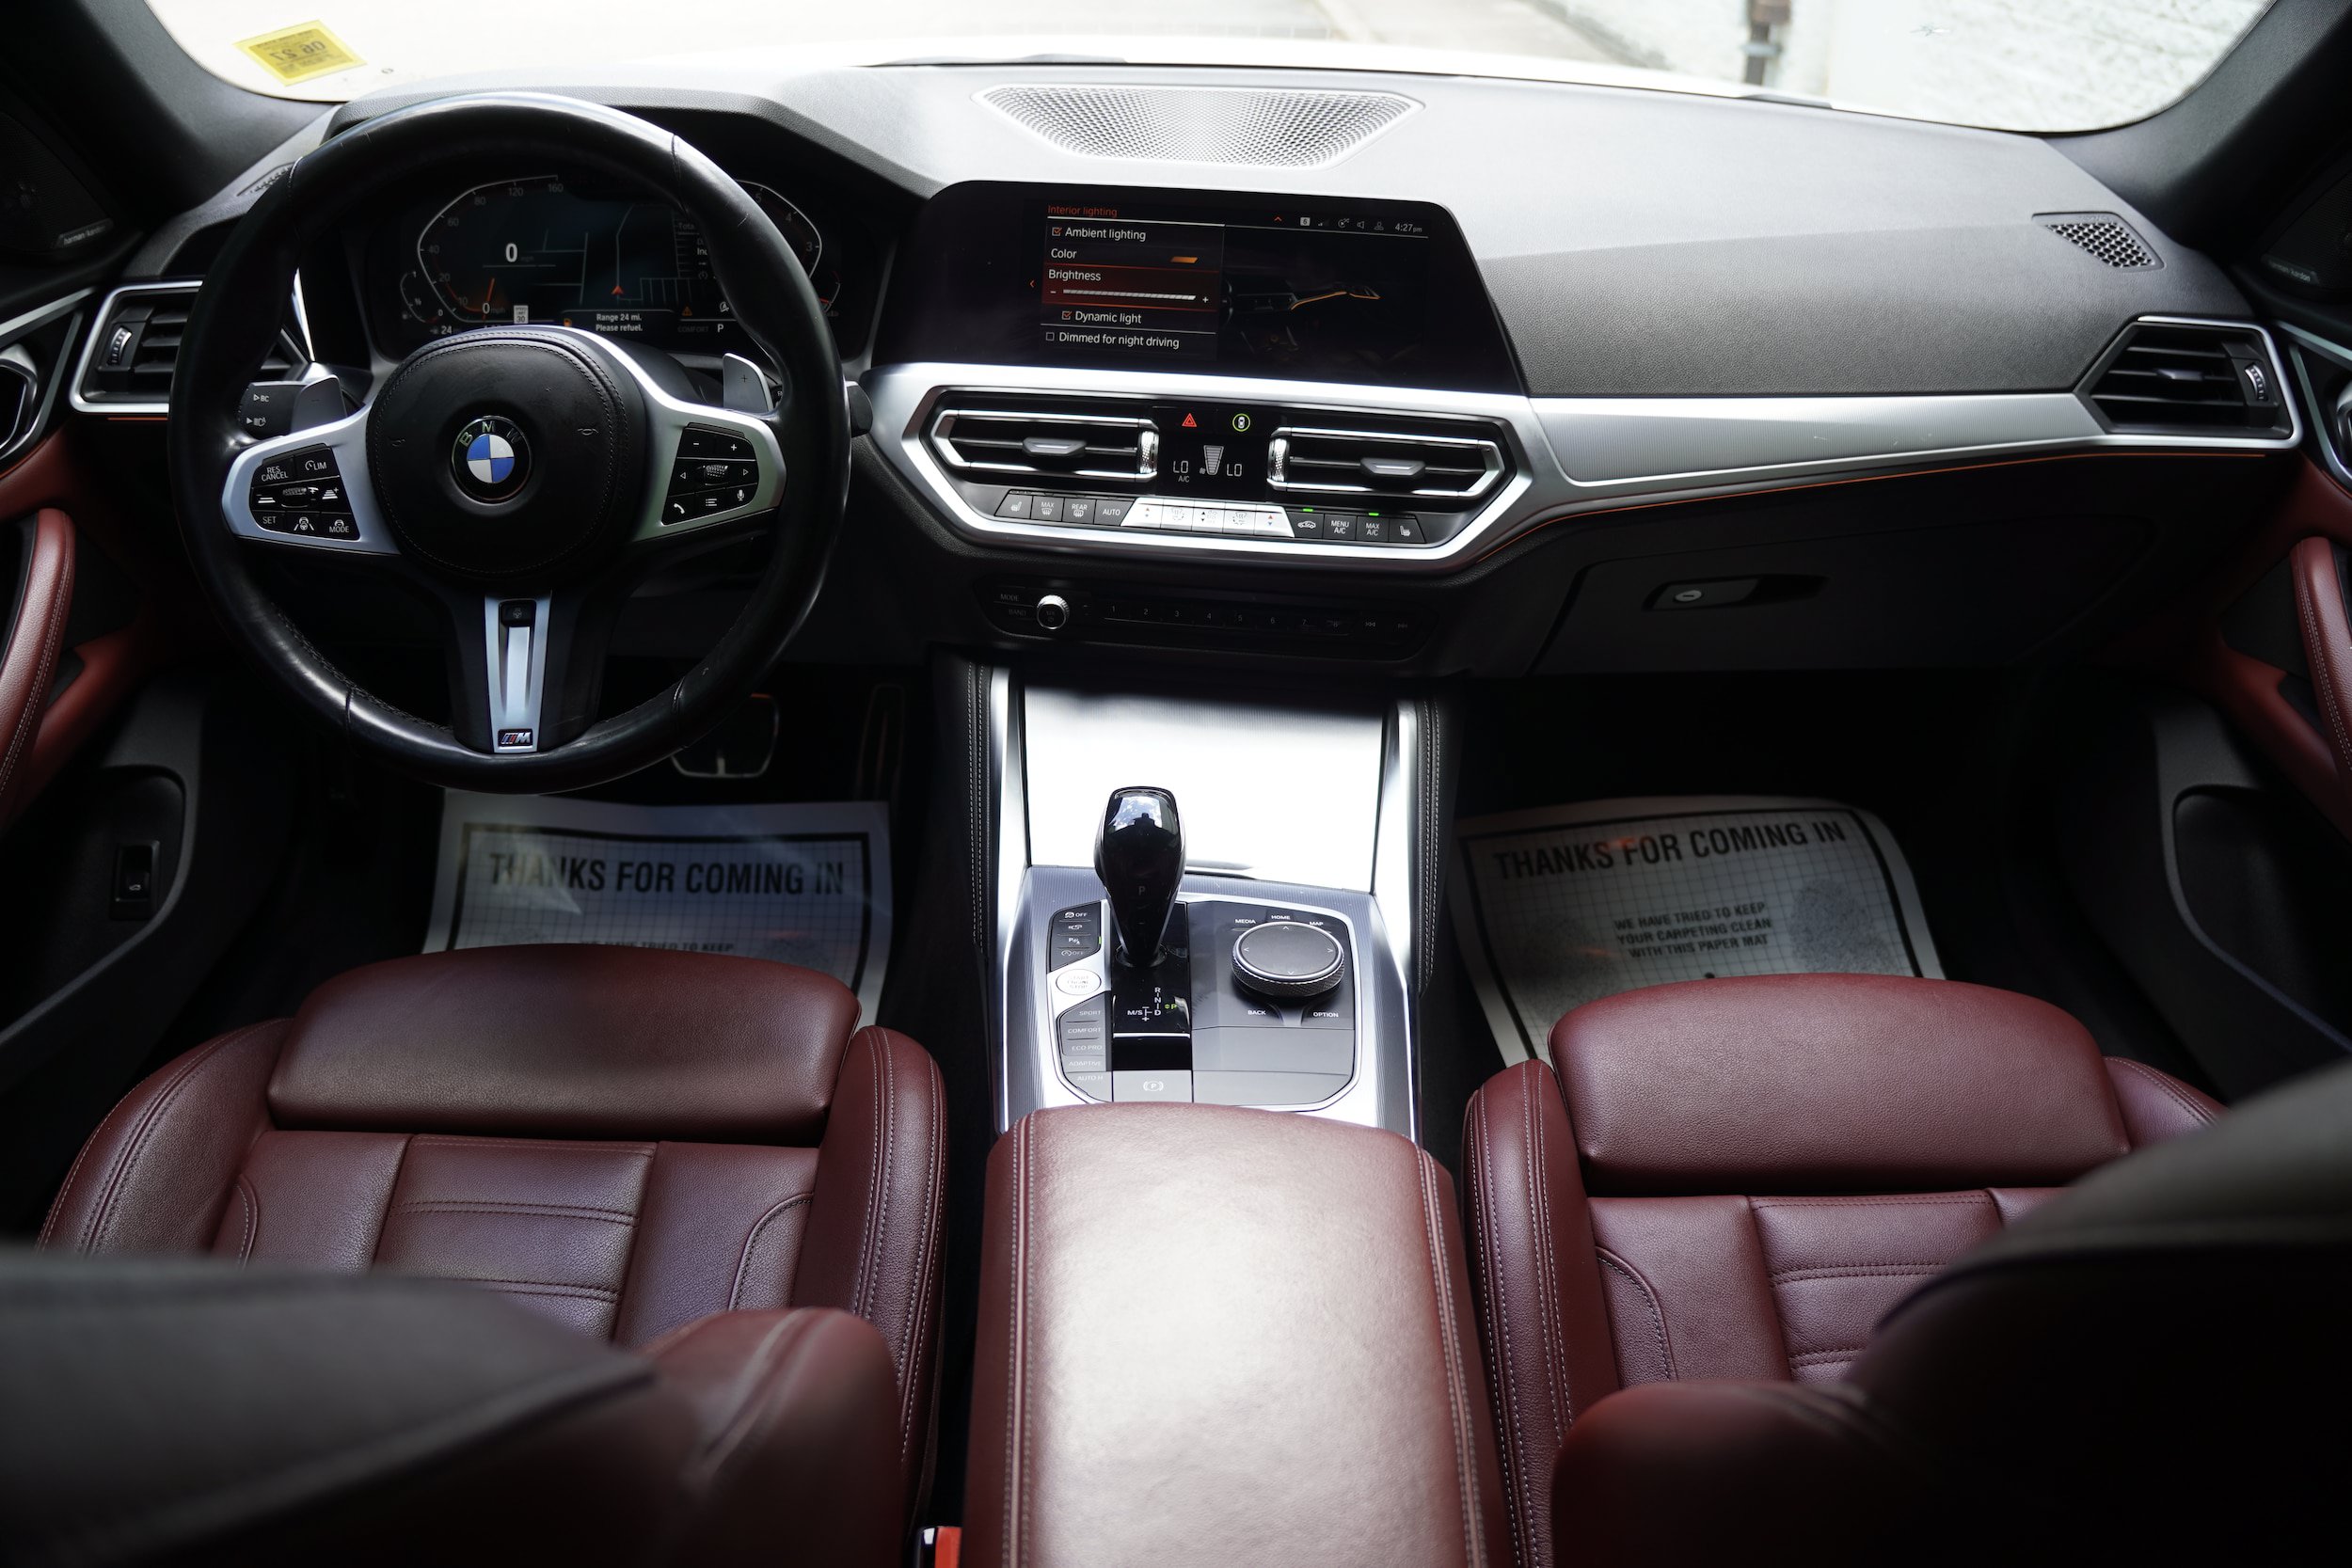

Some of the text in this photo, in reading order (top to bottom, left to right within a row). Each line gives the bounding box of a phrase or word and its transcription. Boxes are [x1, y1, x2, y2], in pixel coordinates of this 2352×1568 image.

[508, 188, 524, 197] 120
[548, 183, 564, 193] 160
[474, 197, 486, 205] 80
[1047, 204, 1119, 219] Interior lighting
[447, 217, 460, 227] 60
[1064, 227, 1148, 243] Ambient lighting
[428, 245, 440, 254] 40
[805, 241, 814, 252] 3
[505, 242, 518, 263] 0
[1050, 247, 1078, 260] Color
[438, 273, 451, 282] 20
[1047, 268, 1103, 282] Brightness
[458, 296, 469, 306] 10
[482, 302, 491, 314] 0
[596, 313, 618, 324] Range
[619, 313, 629, 322] 24
[1074, 310, 1142, 325] Dynamic light
[440, 325, 453, 335] 24
[596, 324, 617, 332] Please
[717, 323, 724, 333] P
[1058, 331, 1180, 350] Dimmed for night driving
[459, 420, 521, 448] BMW
[266, 466, 281, 474] RES
[313, 462, 327, 470] LIM
[261, 471, 289, 482] CANCEL
[1102, 508, 1121, 516] AUTO
[262, 516, 277, 525] SET
[1330, 520, 1350, 529] MENU
[1333, 527, 1346, 535] A/C
[1365, 522, 1380, 531] MAX
[1000, 594, 1020, 603] MODE
[1493, 820, 1846, 879] THANKS FOR COMING IN
[616, 861, 675, 893] FOR
[686, 861, 803, 895] COMING
[815, 861, 844, 895] IN
[1613, 901, 1766, 931] WE HAVE TRIED TO KEEP
[1617, 918, 1772, 945] YOUR CARPETING CLEAN
[702, 942, 734, 953] KEEP
[1629, 934, 1770, 958] WITH THIS PAPER MAT
